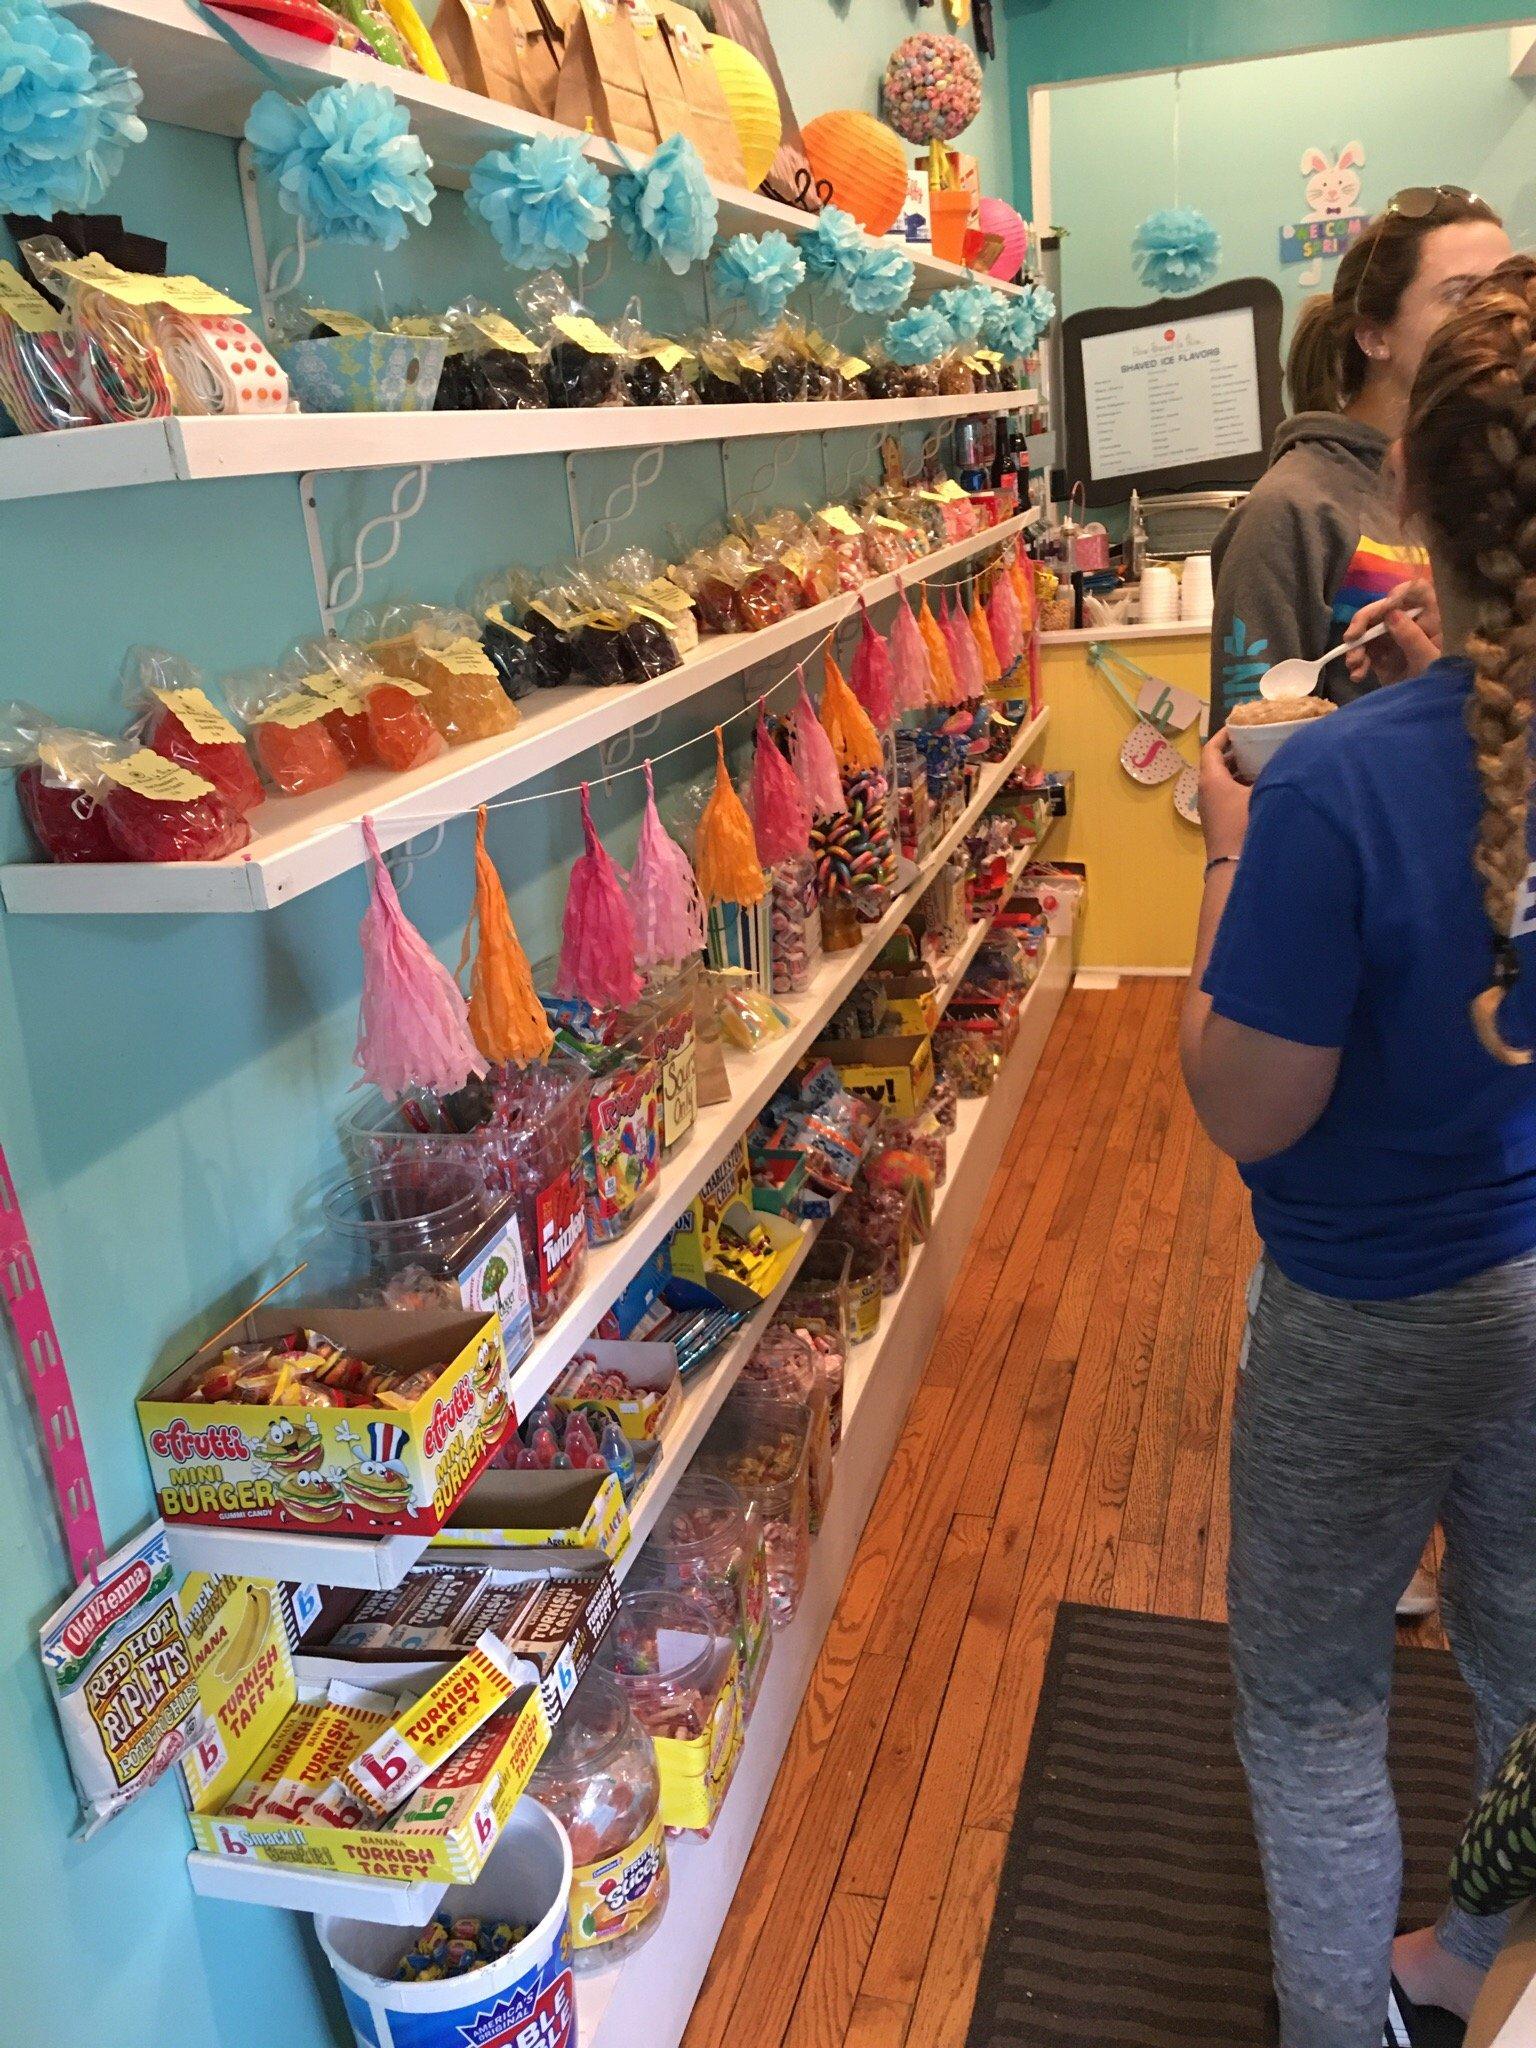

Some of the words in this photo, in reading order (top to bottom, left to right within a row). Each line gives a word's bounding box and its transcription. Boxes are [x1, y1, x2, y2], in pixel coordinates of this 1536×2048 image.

[1121, 359, 1157, 374] SHAVED
[1160, 356, 1175, 367] ICE
[1178, 346, 1221, 363] FLAVORS
[715, 1170, 737, 1206] CHEW
[424, 1375, 476, 1458] efrutti
[151, 1418, 250, 1463] efrutti
[435, 1429, 465, 1482] MINI
[161, 1478, 276, 1515] BURGER
[169, 1464, 223, 1486] MINI
[433, 1429, 487, 1522] BURGER
[219, 1510, 246, 1520] GUMMI
[247, 1509, 273, 1518] CANDY
[547, 1537, 565, 1546] Ages
[408, 1574, 455, 1625] TURKISH
[427, 1580, 465, 1623] TAFFY
[462, 1593, 508, 1646] TURKISH
[489, 1596, 517, 1632] AFFY
[530, 1587, 574, 1640] TURKISH
[549, 1592, 584, 1637] TAFFY
[586, 1582, 613, 1630] TURKISH
[591, 1599, 613, 1639] TAFFY
[89, 1653, 131, 1704] RED
[127, 1607, 174, 1661] HOT
[195, 1625, 228, 1664] NANA
[102, 1640, 190, 1749] RIPLETS
[217, 1643, 279, 1726] TURKISH
[229, 1669, 276, 1740] TAFFY
[430, 1665, 467, 1700] BANANA
[118, 1720, 165, 1778] POTATO
[162, 1679, 199, 1723] CHIPS
[404, 1671, 481, 1743] TURKISH
[422, 1690, 481, 1747] TAFFY
[261, 1720, 314, 1783] TURKISH
[271, 1718, 298, 1750] BANANA
[299, 1718, 350, 1783] TURKISH
[306, 1716, 331, 1748] BANANA
[509, 1714, 539, 1770] TURKISH
[515, 1735, 539, 1778] TAFFY
[240, 1830, 294, 1849] Smack
[342, 1844, 436, 1865] TURKISH
[360, 1836, 407, 1848] BANANA
[356, 1861, 430, 1878] TAFFY
[473, 1991, 534, 2037] AMERICA'S
[478, 2007, 529, 2042] ORIGINAL
